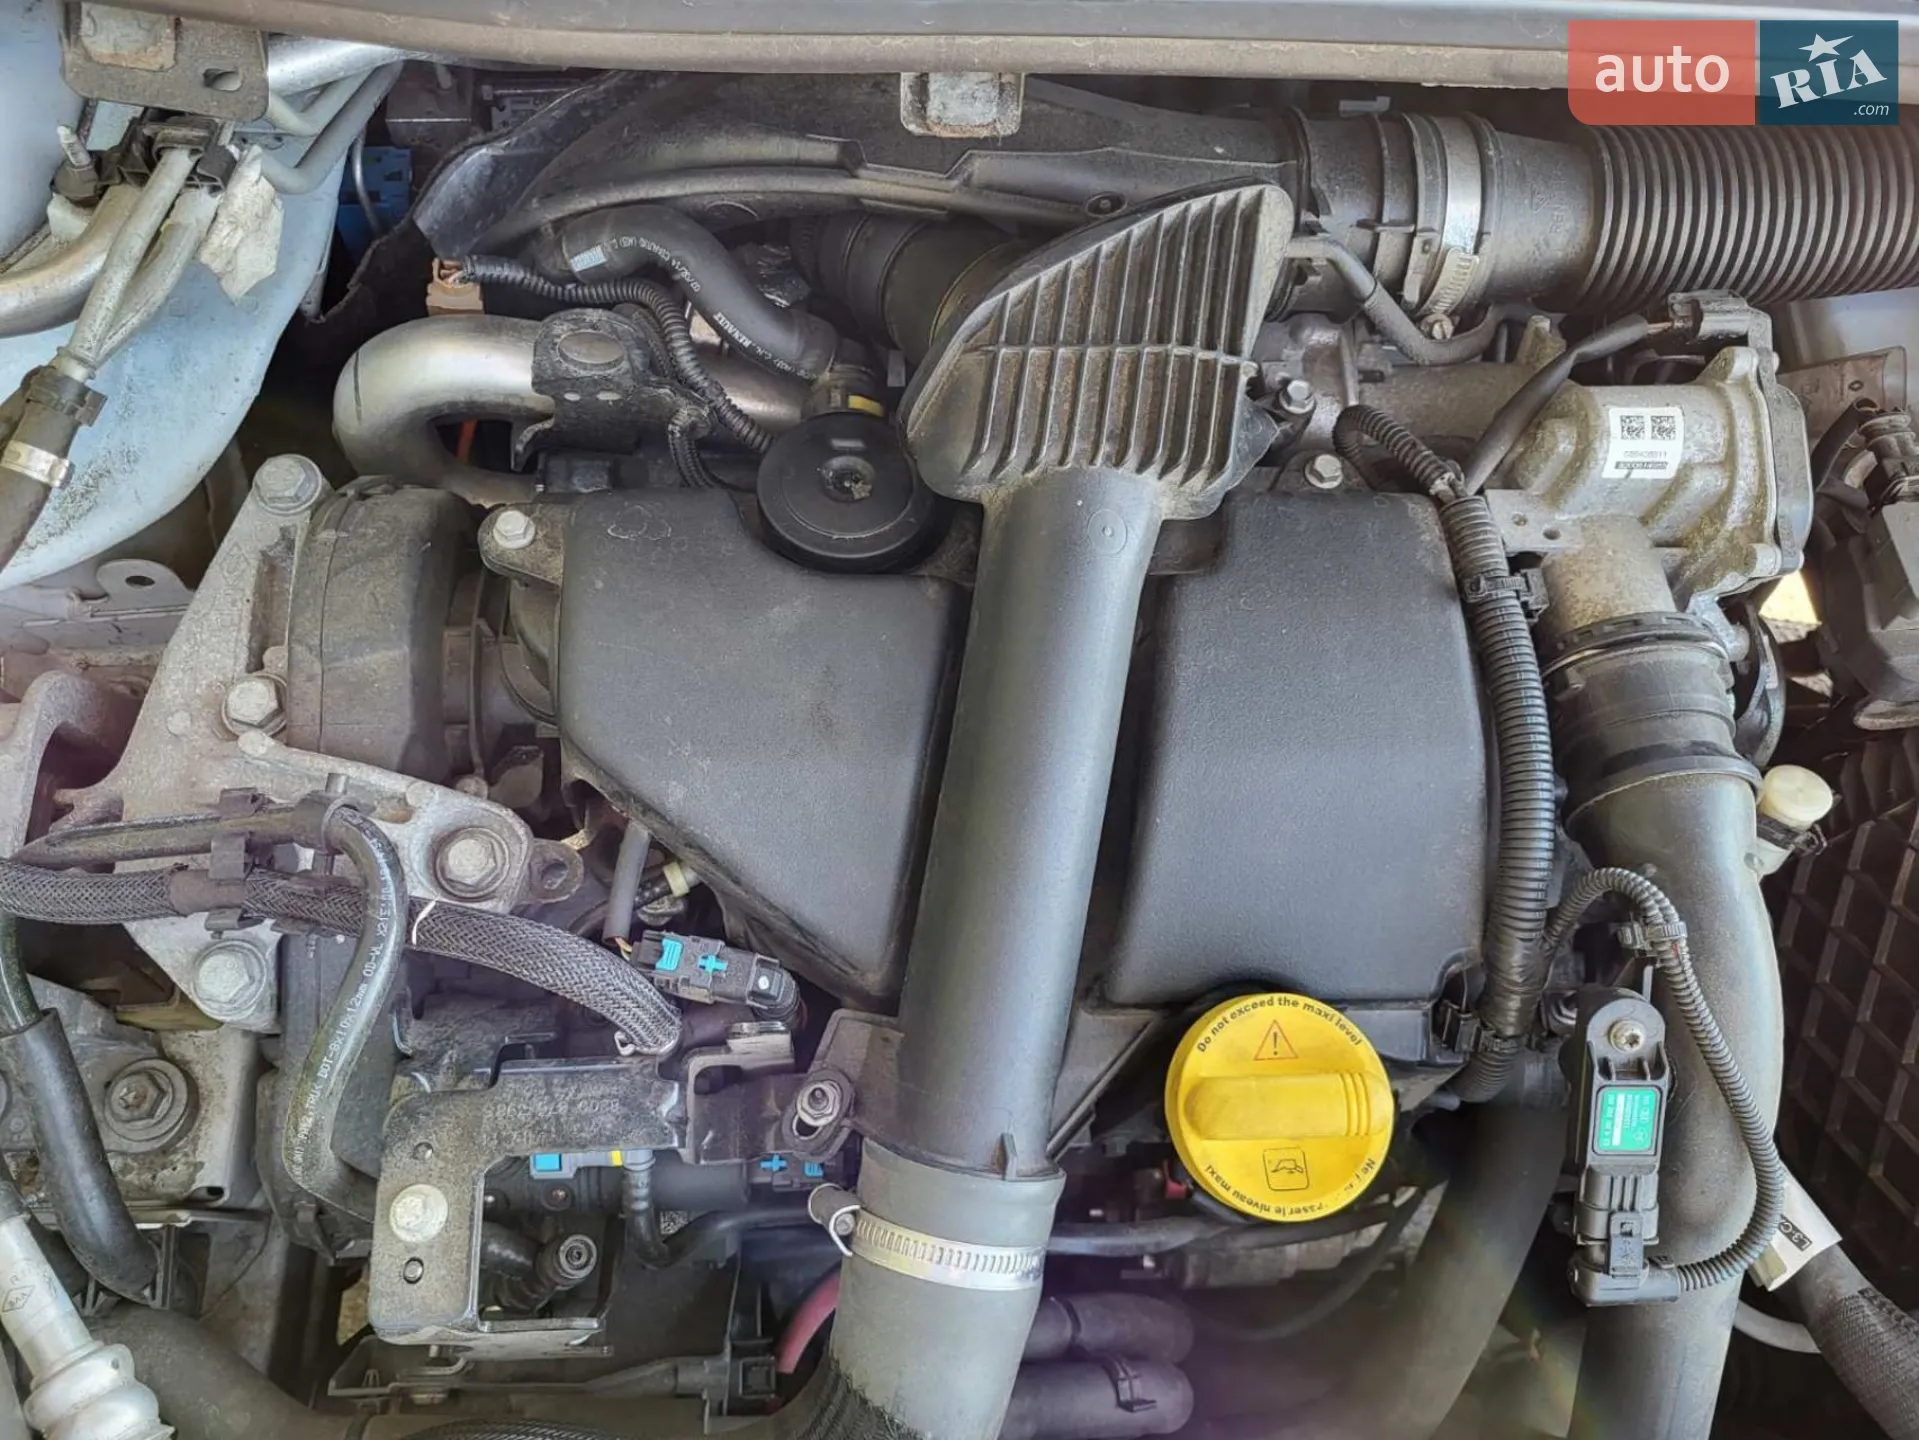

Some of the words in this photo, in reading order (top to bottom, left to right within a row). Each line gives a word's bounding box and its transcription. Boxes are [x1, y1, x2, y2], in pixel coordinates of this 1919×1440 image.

[1196, 1035, 1212, 1053] Do
[1211, 1016, 1230, 1036] not
[1230, 996, 1275, 1021] exceed
[1277, 996, 1300, 1009] the
[1302, 1002, 1337, 1023] maxi
[1335, 1017, 1363, 1046] level
[1204, 1163, 1234, 1194] maxi
[1232, 1188, 1271, 1214] niveau
